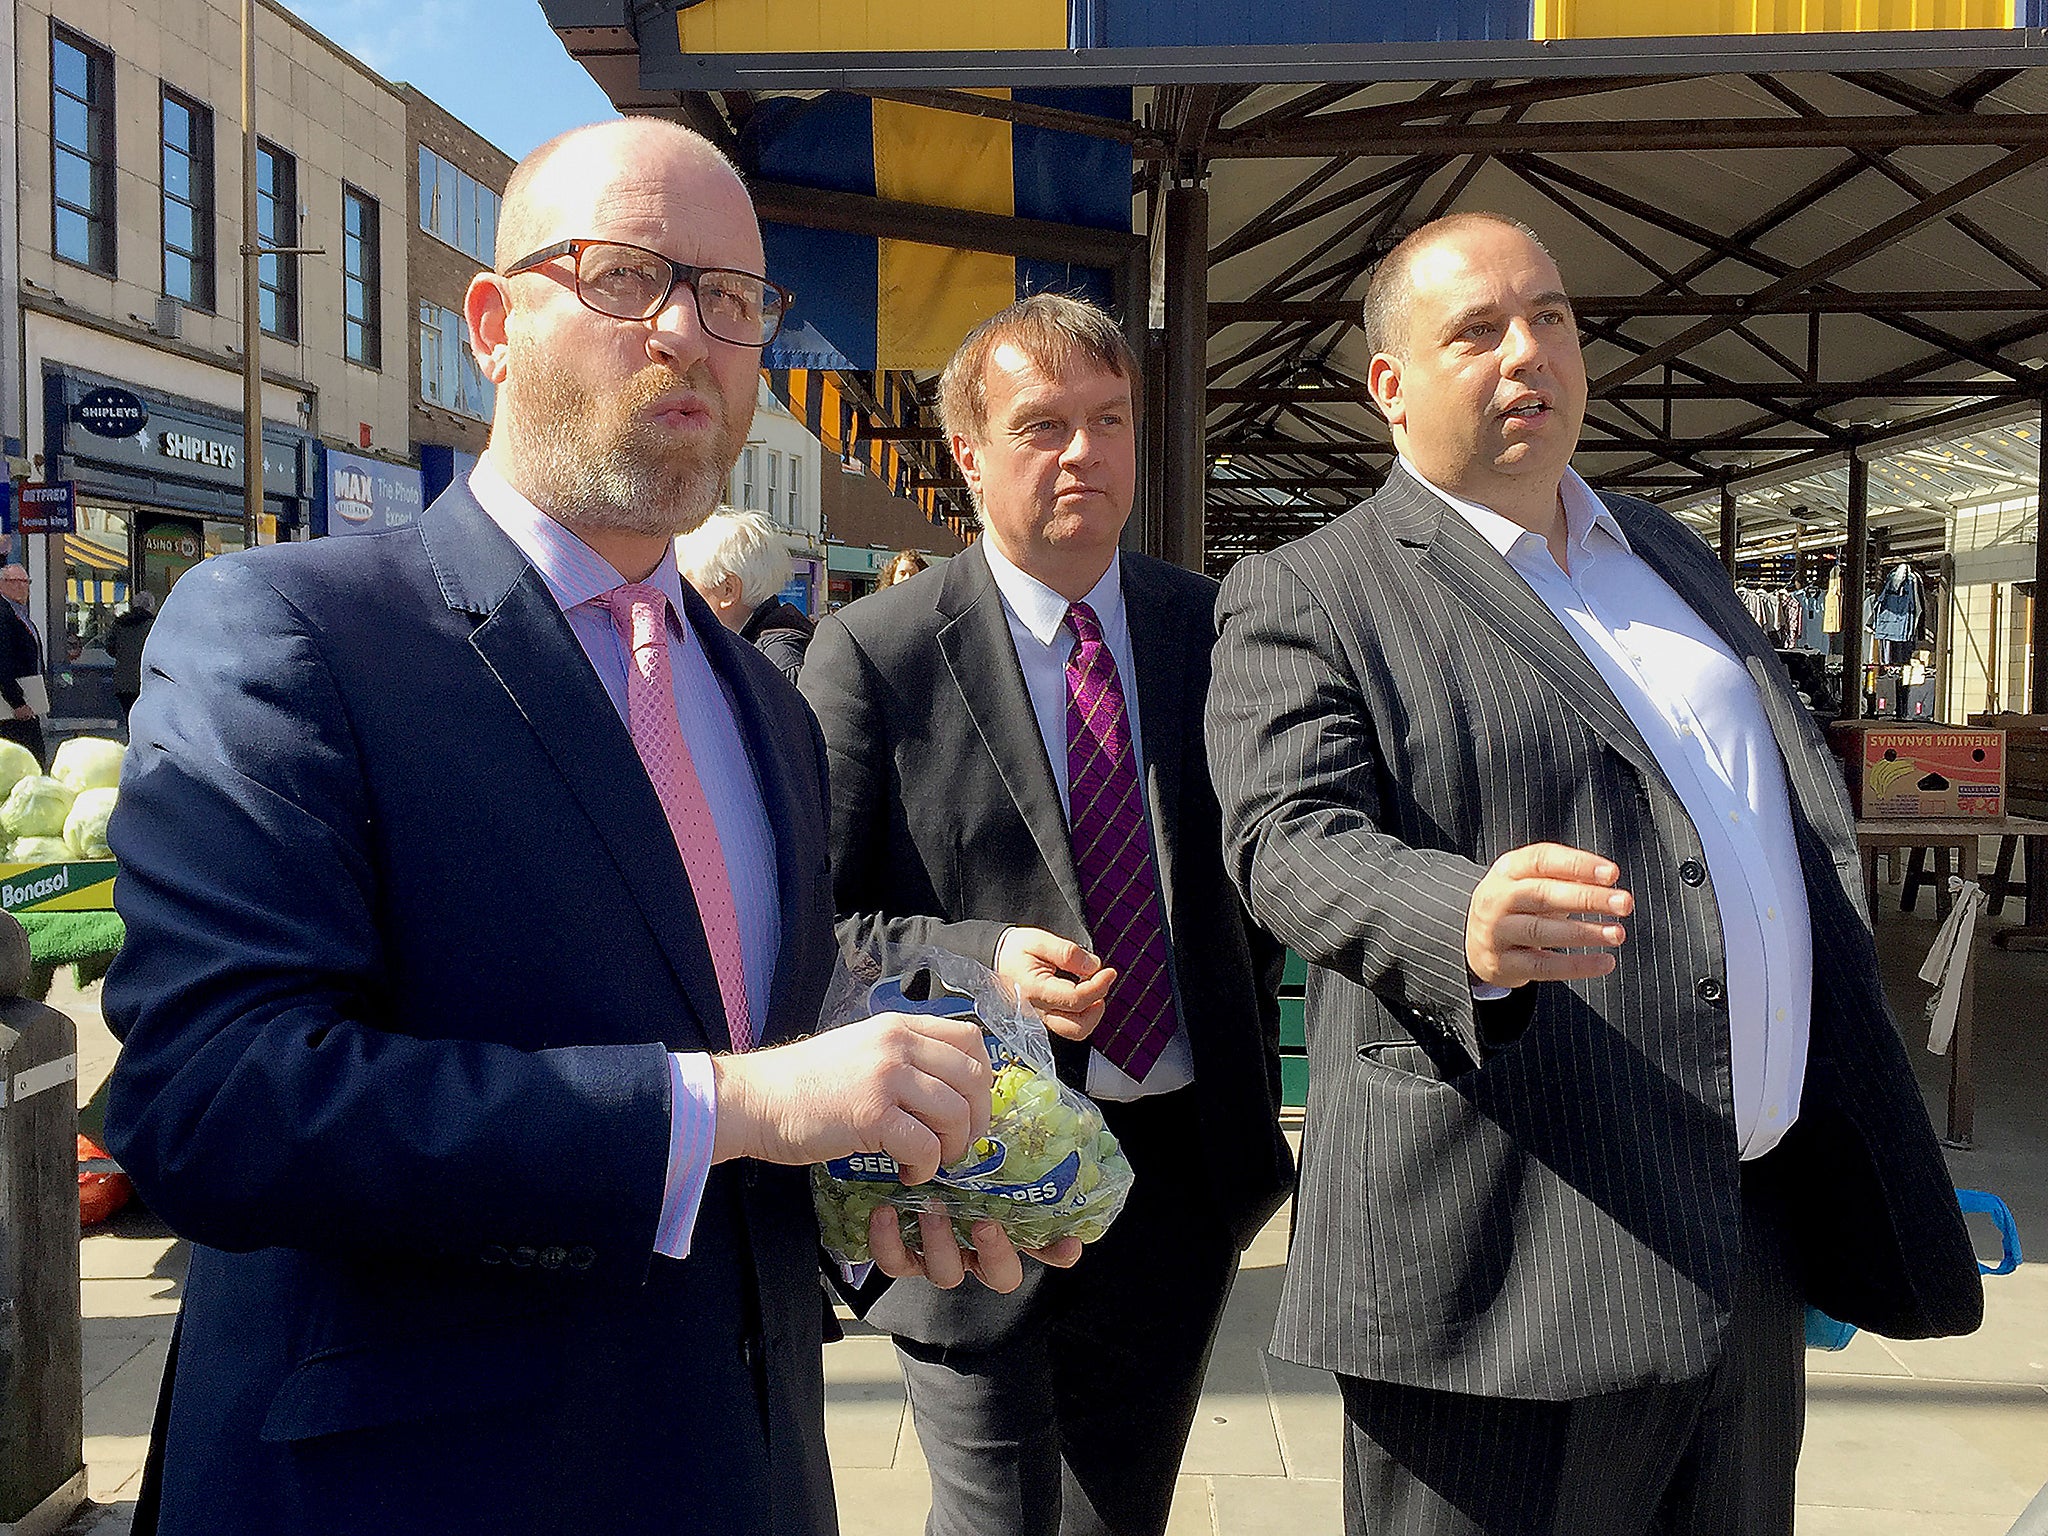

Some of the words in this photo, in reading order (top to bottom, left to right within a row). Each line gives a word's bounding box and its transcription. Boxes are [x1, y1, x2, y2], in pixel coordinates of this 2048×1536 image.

[82, 406, 139, 419] SHIPLEYS
[166, 432, 236, 470] SHIPLEYS
[334, 469, 373, 504] MAX
[377, 478, 394, 500] The
[1870, 735, 1932, 747] BANANAS
[1937, 735, 1998, 747] PREMIUM
[1957, 798, 1999, 815] Dole
[1, 865, 69, 908] Bonasol
